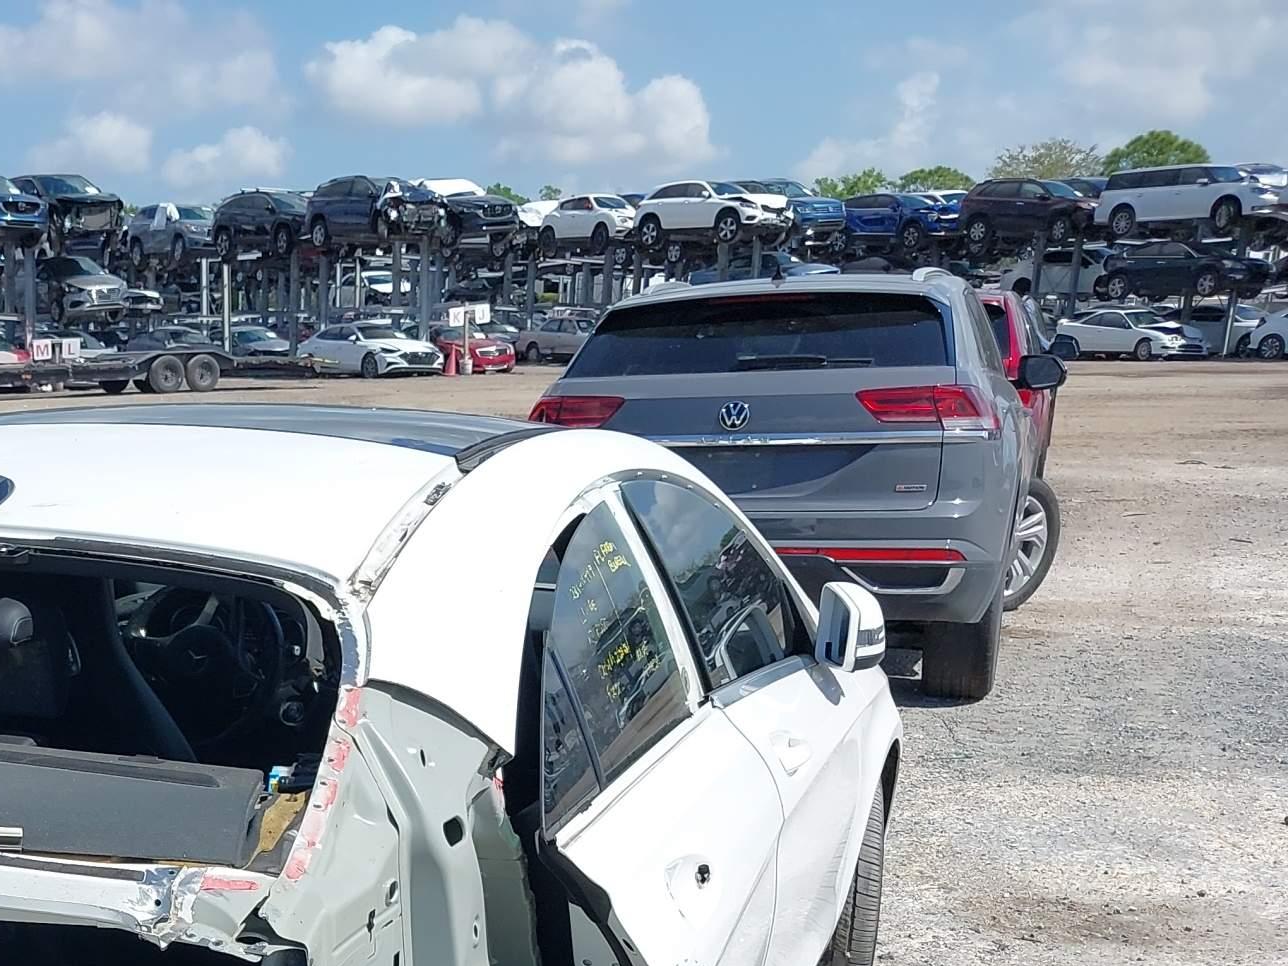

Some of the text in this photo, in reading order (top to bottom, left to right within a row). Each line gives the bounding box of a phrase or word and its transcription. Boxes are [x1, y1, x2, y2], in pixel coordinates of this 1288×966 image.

[453, 311, 462, 323] K
[36, 343, 50, 357] M
[67, 343, 75, 355] L
